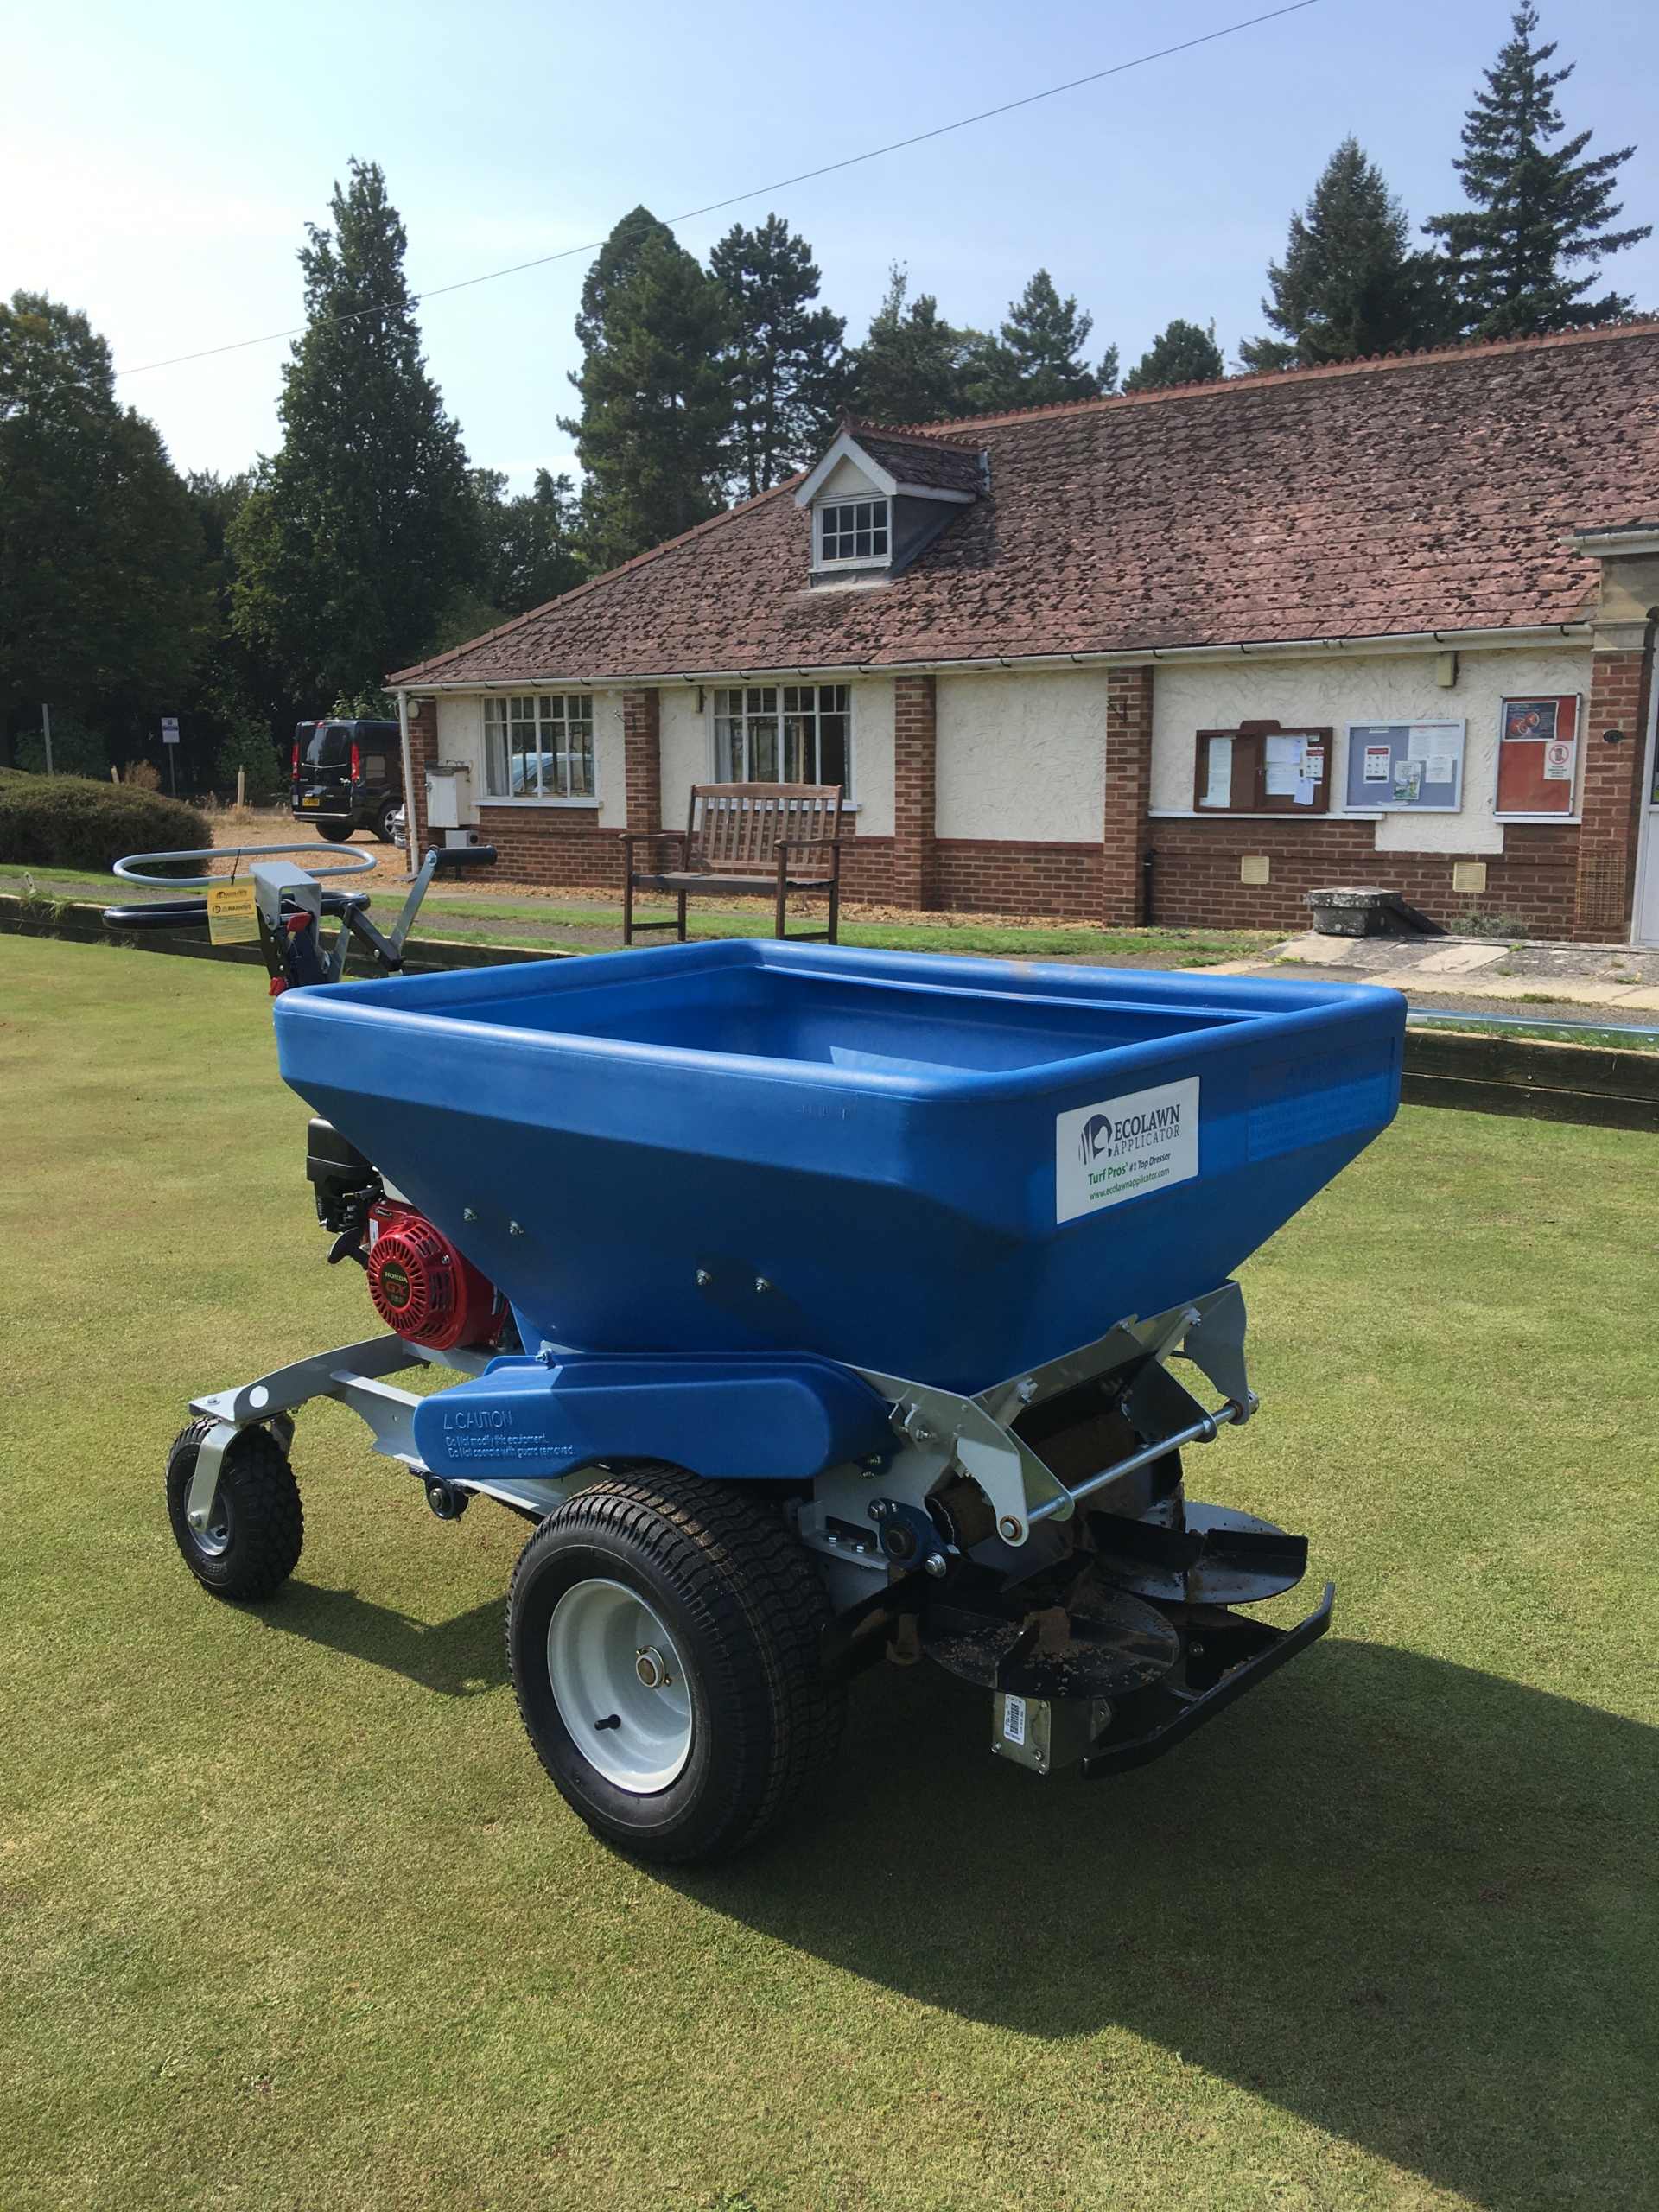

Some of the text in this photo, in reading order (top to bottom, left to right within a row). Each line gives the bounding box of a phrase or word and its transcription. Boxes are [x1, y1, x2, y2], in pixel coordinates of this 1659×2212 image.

[1114, 1103, 1180, 1142] ECOLAWN
[1113, 1124, 1180, 1157] APPLICATOR
[1088, 1168, 1107, 1185] Turf
[1129, 1162, 1137, 1173] #1
[1138, 1160, 1149, 1170] Top
[1148, 1153, 1172, 1166] Dresser
[1089, 1168, 1170, 1201] www.ecolawnapplicator.com
[385, 1271, 409, 1284] HONDA
[385, 1281, 407, 1297] GX
[455, 1410, 513, 1429] CAUTION
